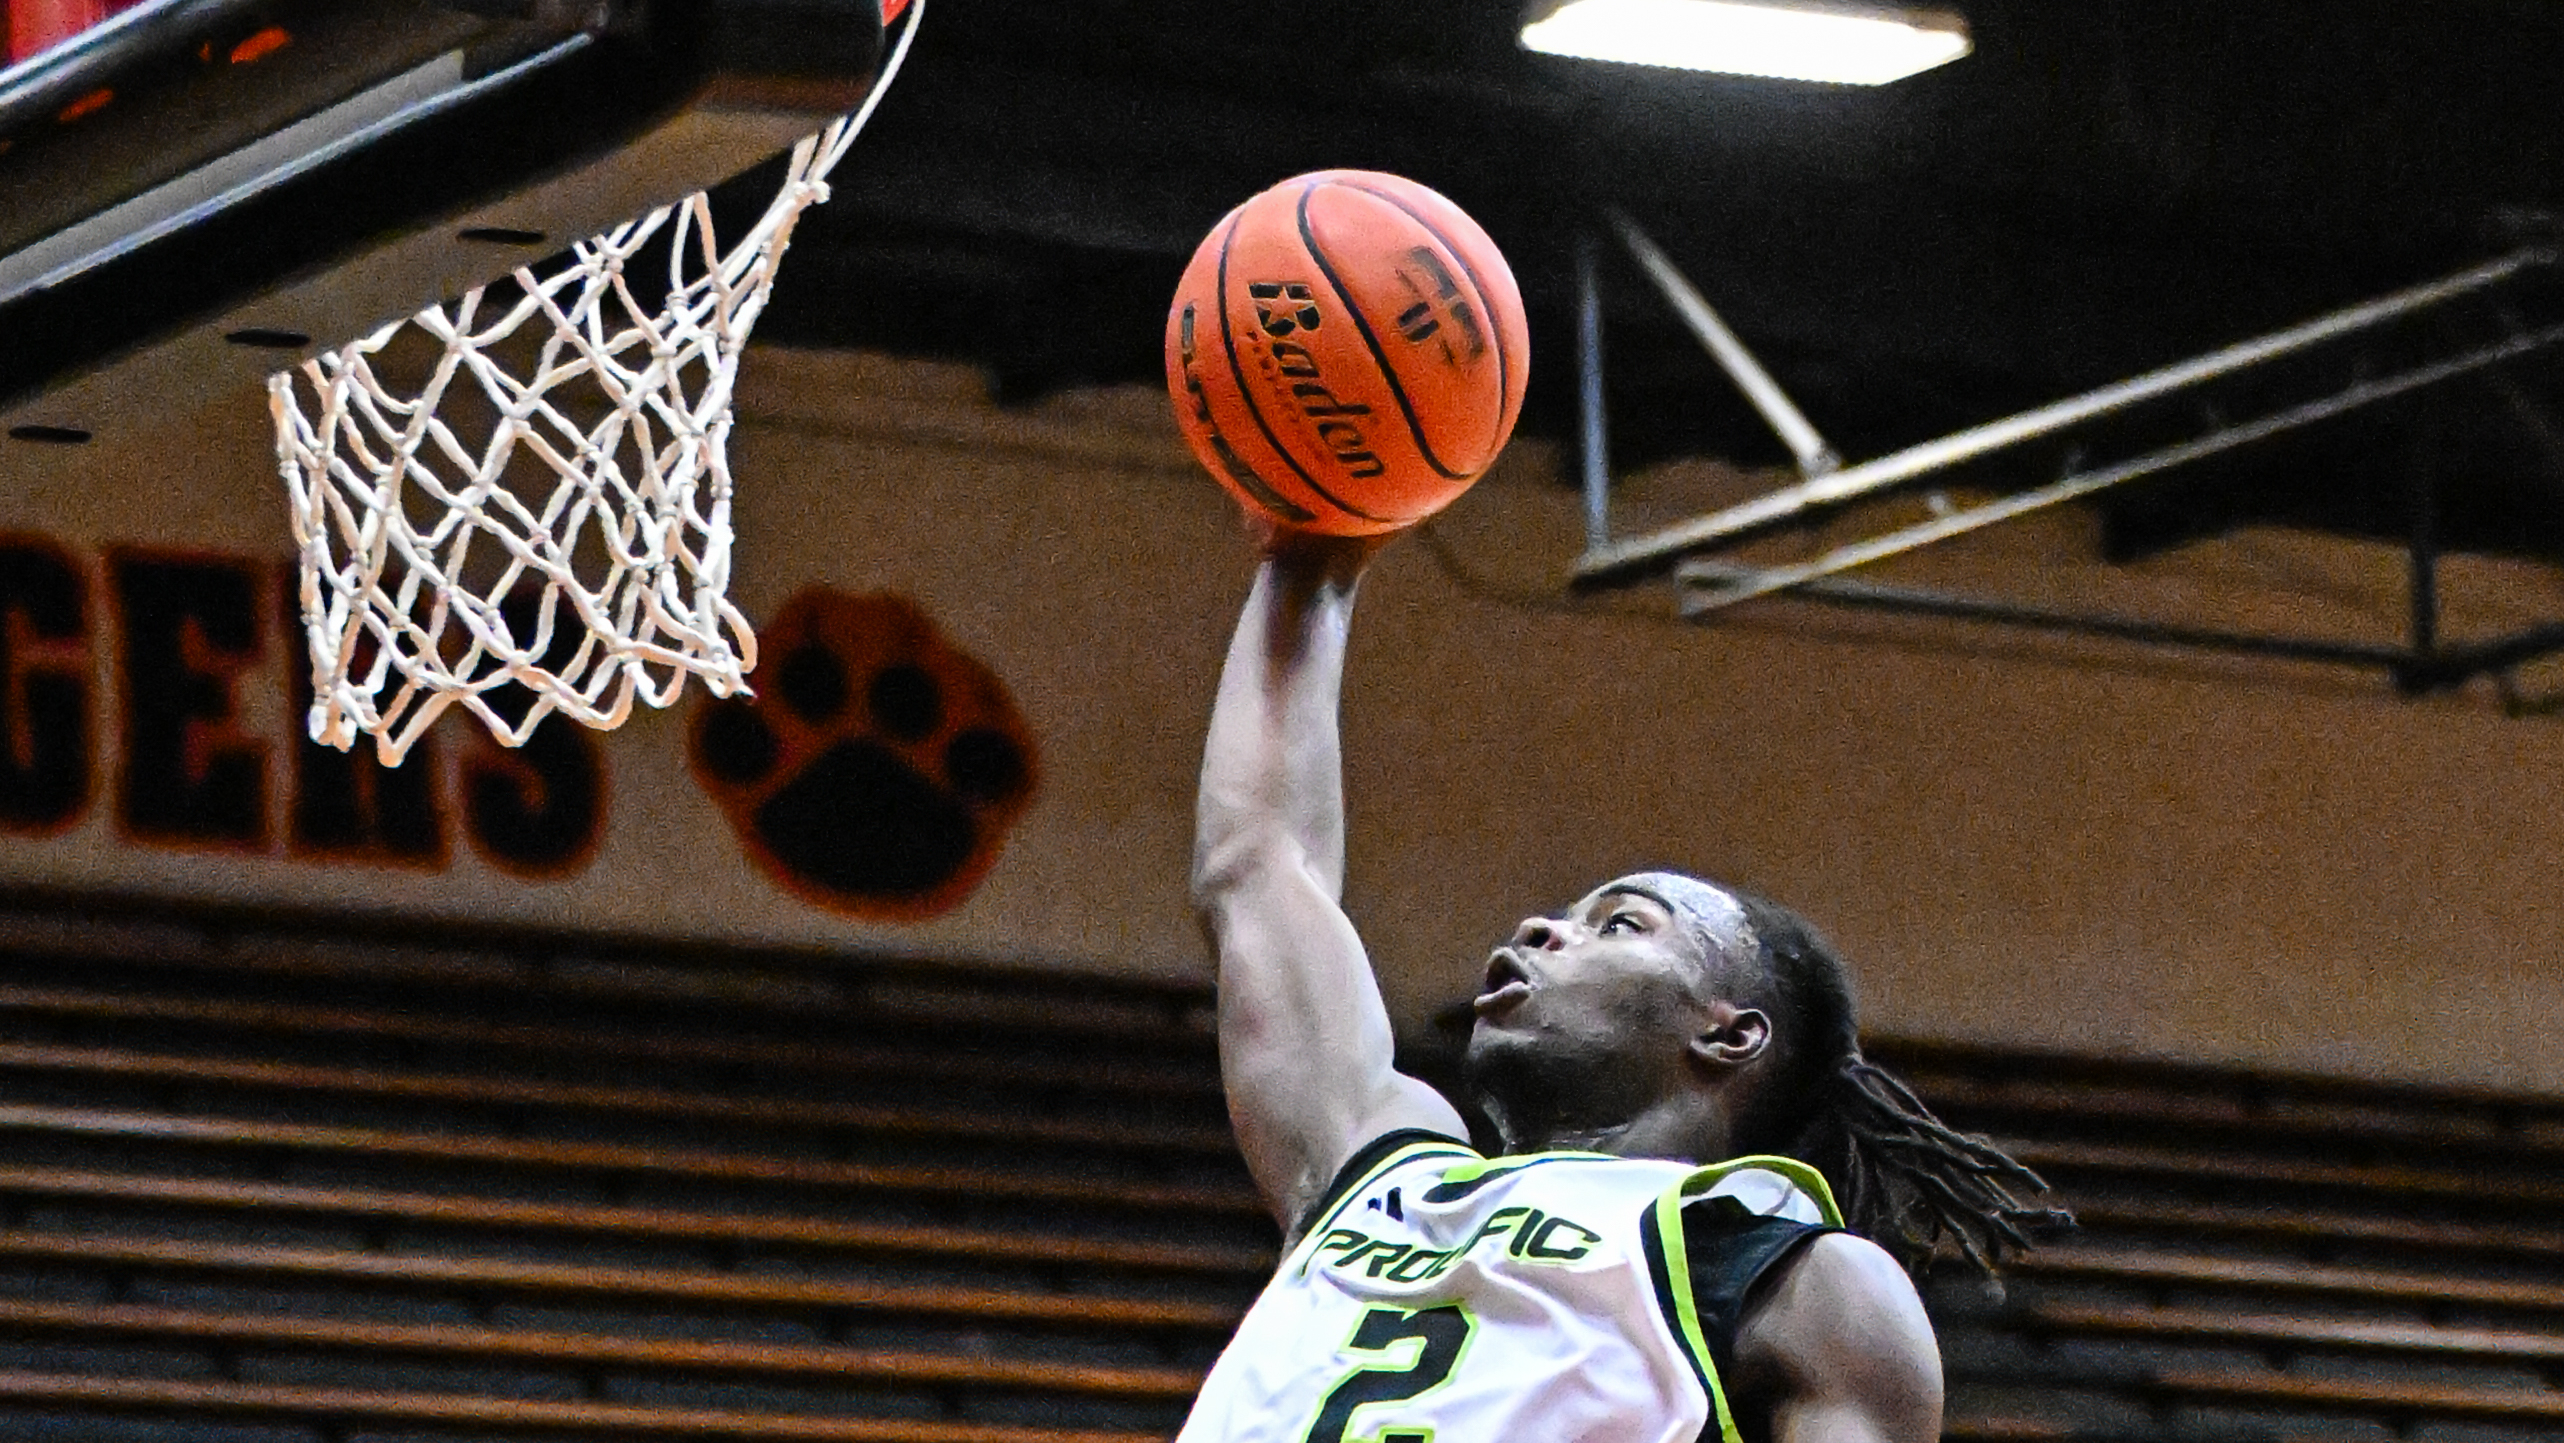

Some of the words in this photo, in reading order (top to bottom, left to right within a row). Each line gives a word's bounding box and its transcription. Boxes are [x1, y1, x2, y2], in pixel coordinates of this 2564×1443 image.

[1247, 281, 1385, 480] Baden
[1299, 1206, 1603, 1284] PROLFIC
[1303, 1303, 1475, 1443] 2
